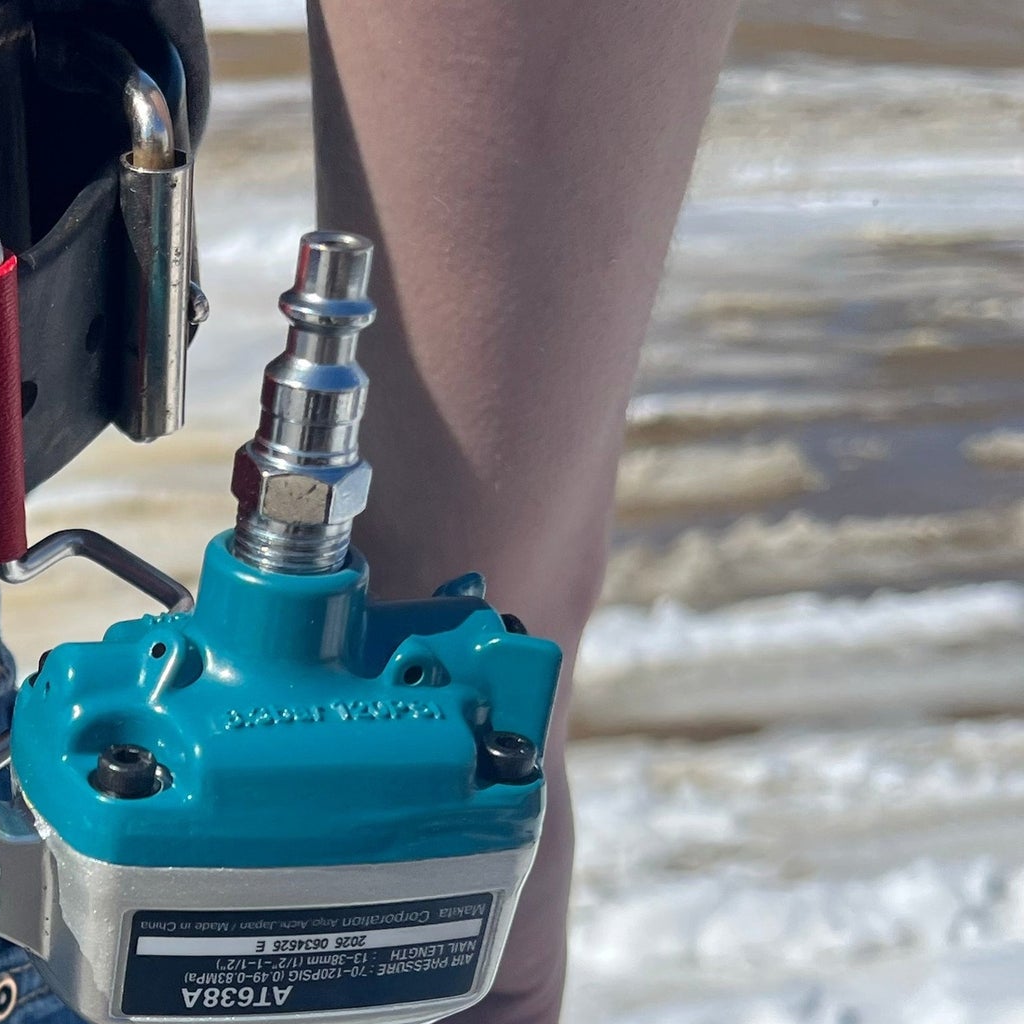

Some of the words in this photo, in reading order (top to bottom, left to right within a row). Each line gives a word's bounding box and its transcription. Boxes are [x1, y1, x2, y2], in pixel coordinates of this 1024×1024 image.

[439, 903, 487, 919] Makita
[140, 920, 177, 932] China
[342, 910, 430, 928] Corporation
[180, 922, 191, 931] in
[194, 922, 230, 932] Made
[255, 940, 266, 953] E
[390, 944, 444, 961] LENGTH
[448, 940, 477, 953] NAIL
[377, 956, 449, 976] PRESSURE
[450, 953, 474, 967] AIR
[181, 985, 293, 1008] AT638A
